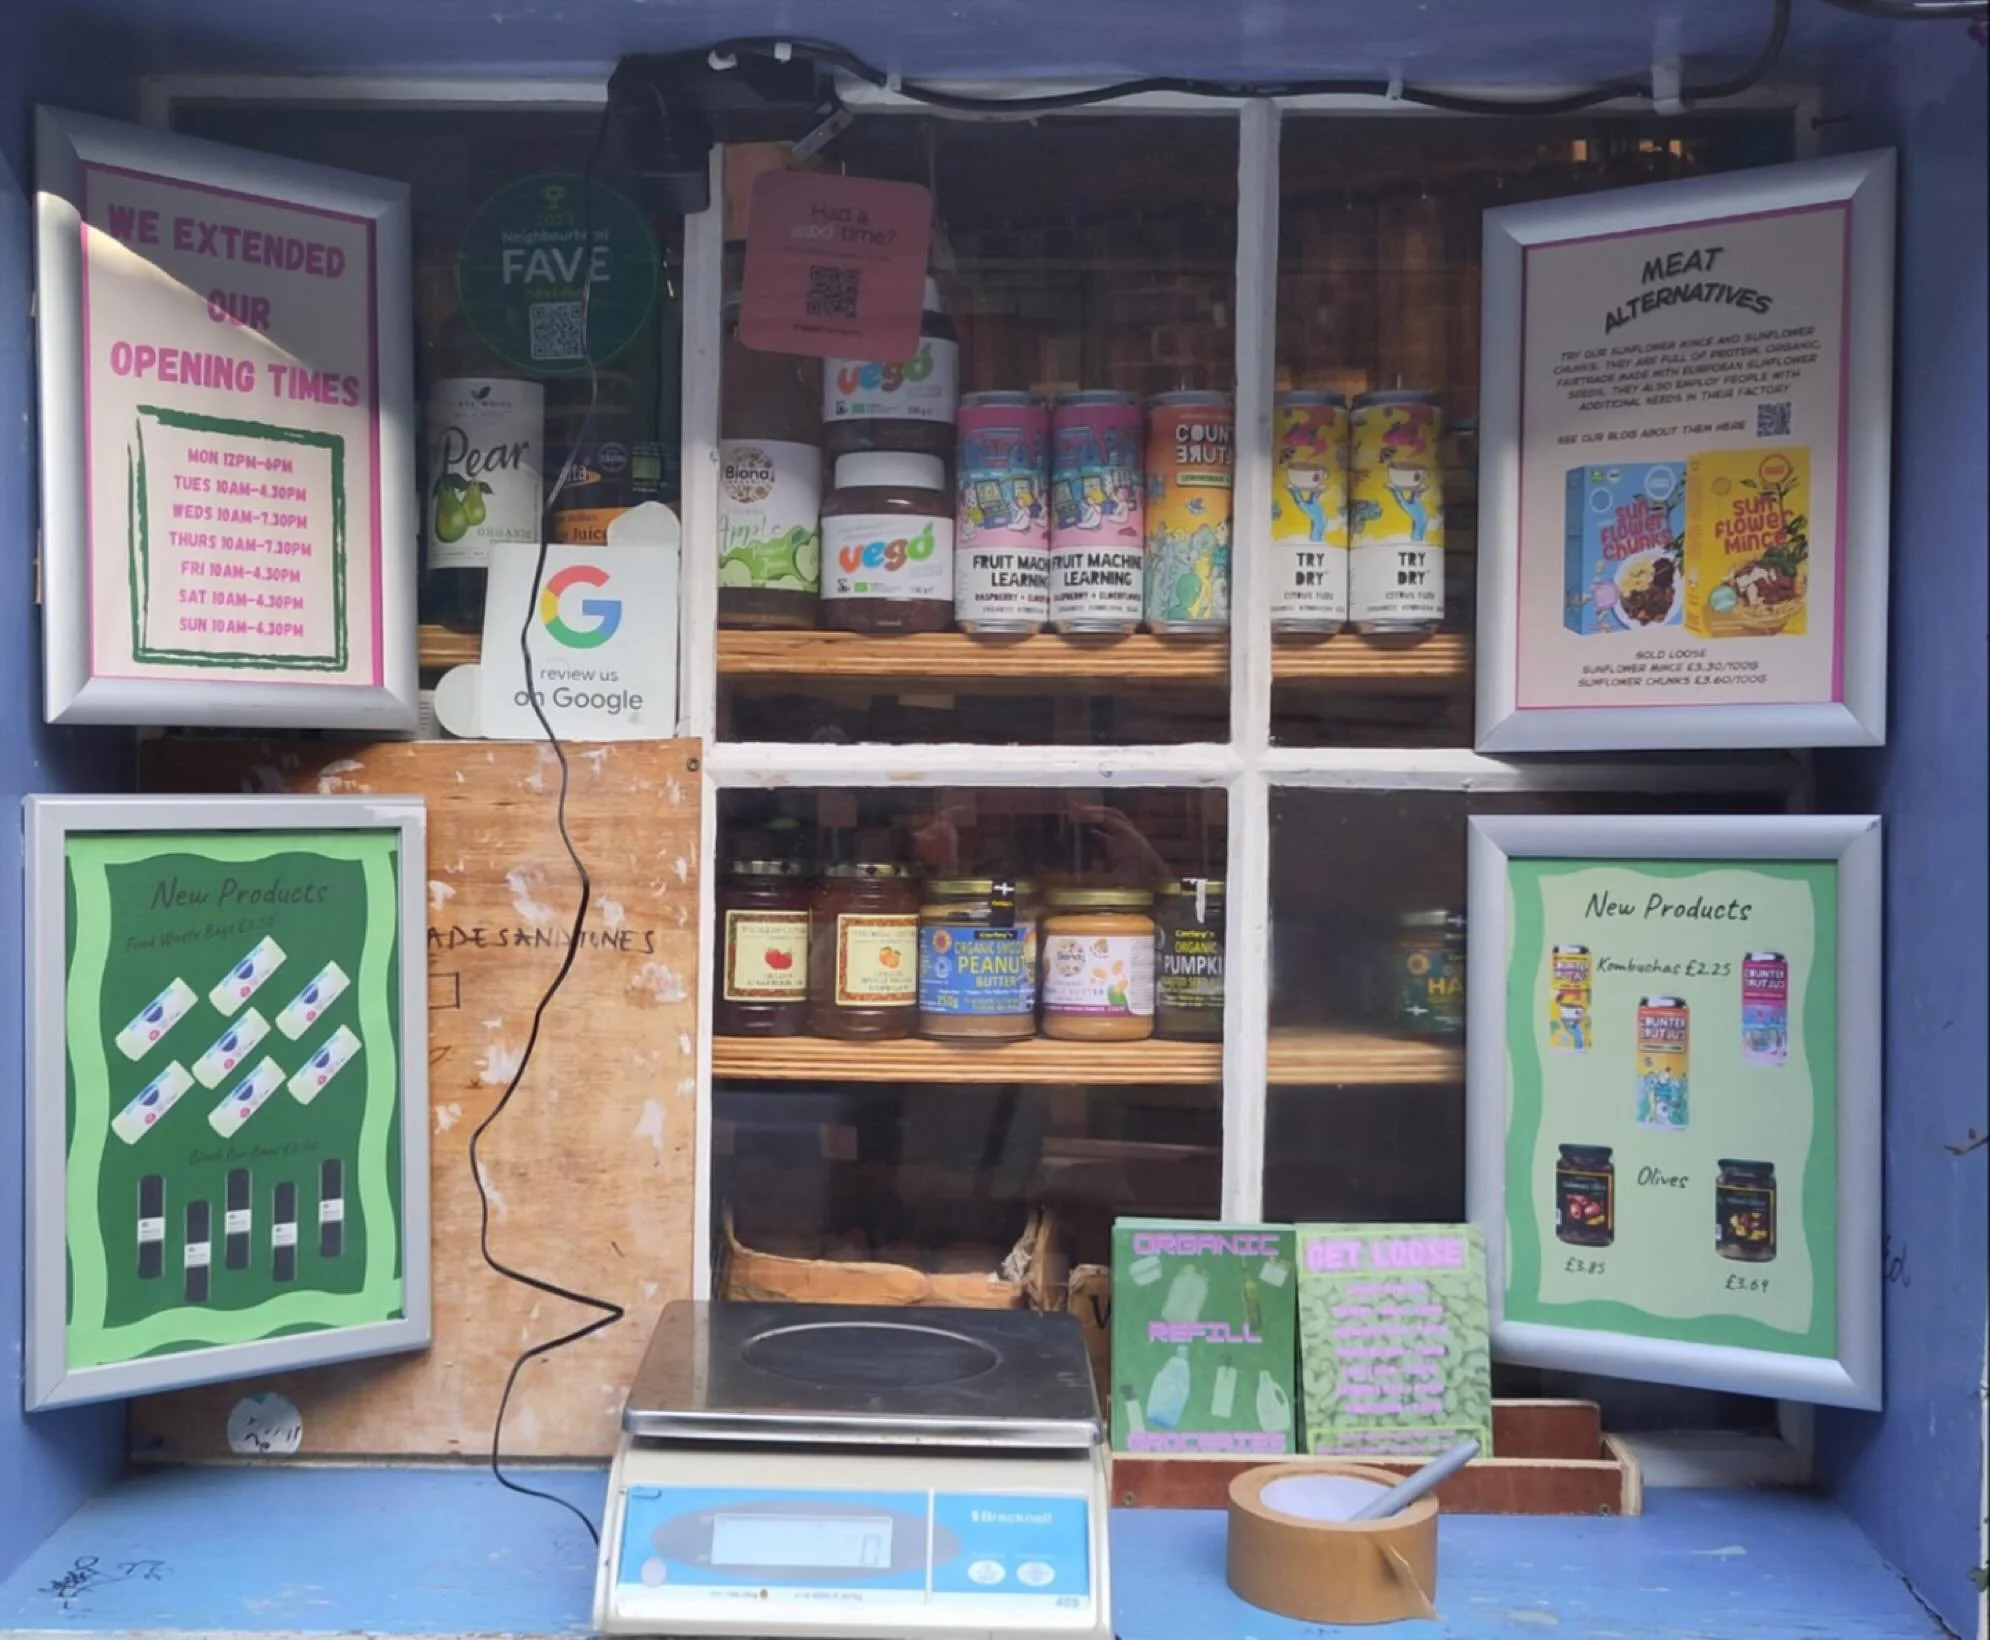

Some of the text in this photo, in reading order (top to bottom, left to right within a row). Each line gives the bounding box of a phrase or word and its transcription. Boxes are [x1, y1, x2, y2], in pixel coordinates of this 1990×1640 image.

[810, 200, 851, 223] Had
[109, 203, 346, 279] WE EXTENDED
[841, 225, 897, 245] time?
[502, 246, 611, 285] FAVE
[1641, 247, 1724, 285] MEAT
[207, 288, 271, 331] OUR
[1605, 282, 1773, 335] ALTERNATIVES
[1561, 326, 1815, 362] TRY OUR SUNFLOWER MINCE AND SUNFLOWER
[1556, 374, 1615, 387] FAIRTRADE
[1618, 370, 1649, 382] MADE
[1652, 367, 1679, 378] WITH
[1747, 353, 1818, 369] SUNFLOWER
[1605, 359, 1633, 370] THEY
[1635, 356, 1658, 367] ARE
[1661, 353, 1687, 363] FULL
[1690, 351, 1708, 362] OF
[110, 340, 360, 408] OPENING TIMES
[1611, 384, 1639, 396] THEY
[1642, 381, 1673, 392] ALSO
[1675, 377, 1721, 389] EMPLOY
[1723, 372, 1768, 385] PEOPLE
[1772, 369, 1801, 380] WITH
[1578, 384, 1791, 411] ADDITIONAL NEEDS IN THEIR FACTORY
[1557, 420, 1746, 445] SEE OUR BLOG ABOUT THEM HERE
[188, 448, 218, 466] MON
[438, 425, 530, 487] Pear
[725, 465, 769, 480] Biona
[173, 475, 307, 502] TUES 10AM-4.30PM
[172, 503, 308, 529] WEDS 10AM-7.30PM
[169, 531, 312, 557] THURS 10AM-7.30PM
[973, 553, 1014, 569] FRUIT
[1052, 553, 1084, 569] FRUIT
[1296, 552, 1325, 567] TRY
[1397, 552, 1426, 567] TRY
[181, 561, 301, 583] FRI 10AM-4.30PM
[1064, 570, 1132, 587] LEARNING
[1295, 571, 1325, 586] DRY
[1397, 571, 1427, 586] DRY
[179, 589, 304, 610] SAT 10AM-4.30PM
[540, 564, 622, 649] G
[179, 617, 304, 637] SUN 10AM-4.30PM
[1669, 648, 1707, 659] LOOSE
[540, 668, 619, 682] review us
[1582, 663, 1646, 674] SUNFLOWER
[1650, 662, 1684, 673] MINCE
[1578, 677, 1643, 688] SUNFLOWER
[1645, 676, 1690, 686] CHUNKS
[514, 687, 643, 715] on Google
[150, 875, 328, 910] New Products
[1585, 890, 1752, 921] New Products
[958, 955, 1025, 975] PEANUT
[1597, 956, 1681, 976] Kombuchas
[1685, 960, 1732, 978] £2.25
[1636, 1165, 1689, 1188] Olives
[1132, 1232, 1280, 1257] ORGANIC
[1307, 1236, 1463, 1272] GET LOOSE
